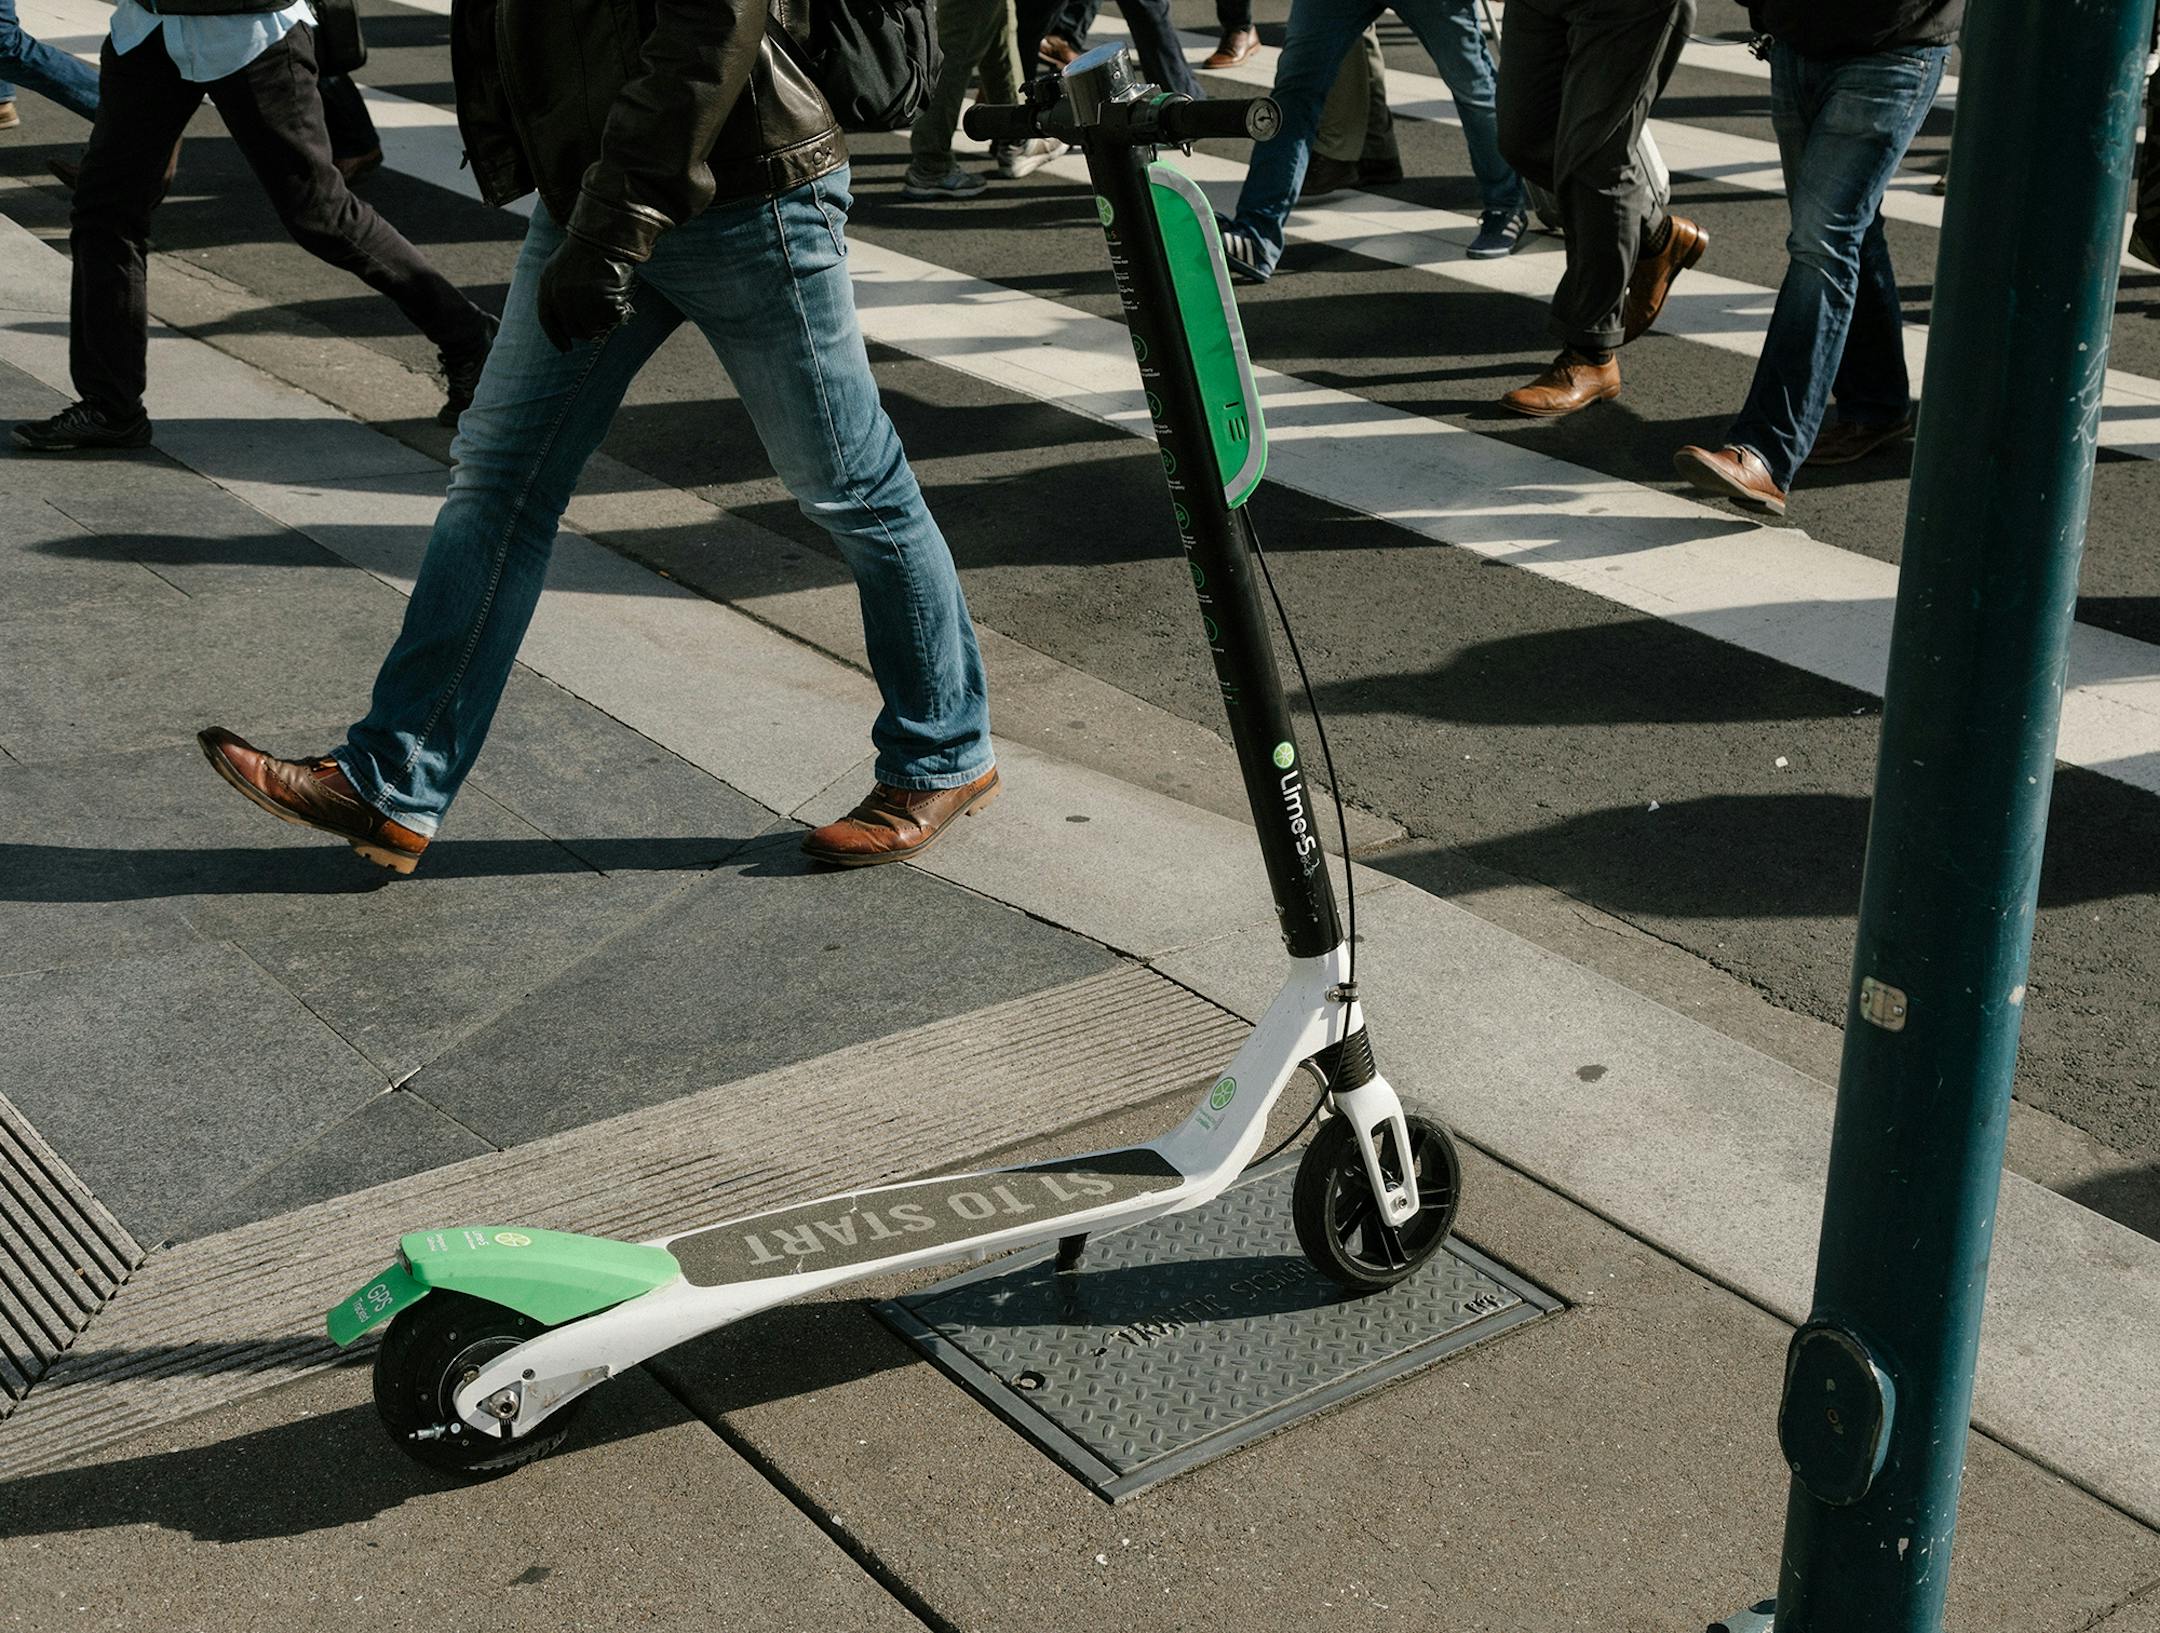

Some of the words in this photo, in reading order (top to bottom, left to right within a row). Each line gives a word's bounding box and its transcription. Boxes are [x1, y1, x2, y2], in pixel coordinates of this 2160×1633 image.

[947, 1184, 1036, 1221] TO
[744, 1202, 936, 1267] START
[367, 1283, 394, 1313] GPS
